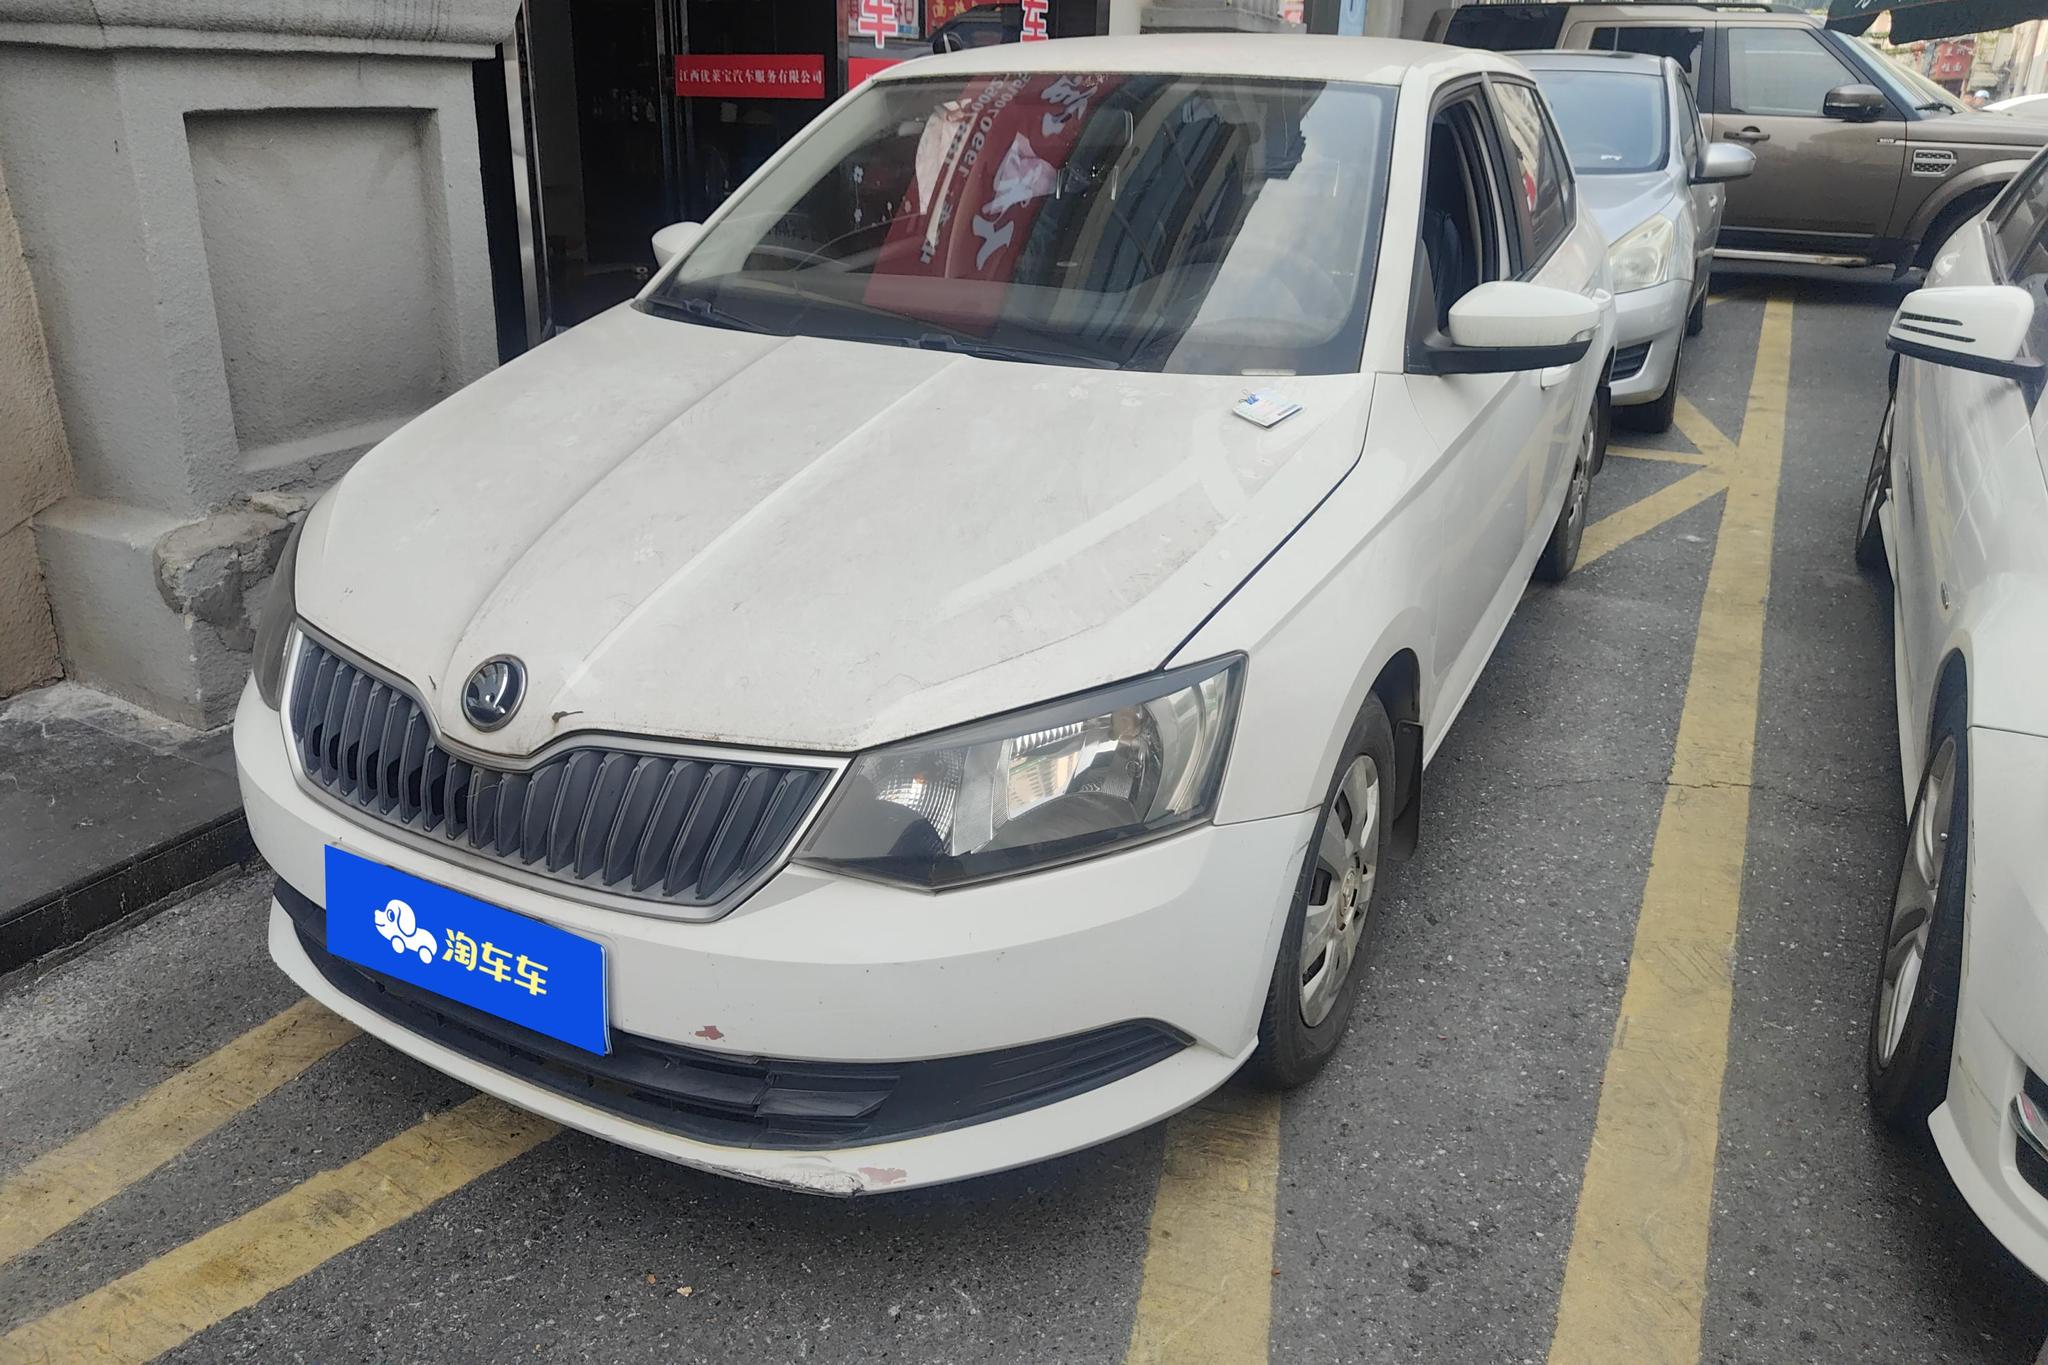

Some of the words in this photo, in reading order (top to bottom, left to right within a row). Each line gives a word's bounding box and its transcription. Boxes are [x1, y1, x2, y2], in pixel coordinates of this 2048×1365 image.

[678, 68, 823, 84] 江西优莱宝汽车服务有限公司
